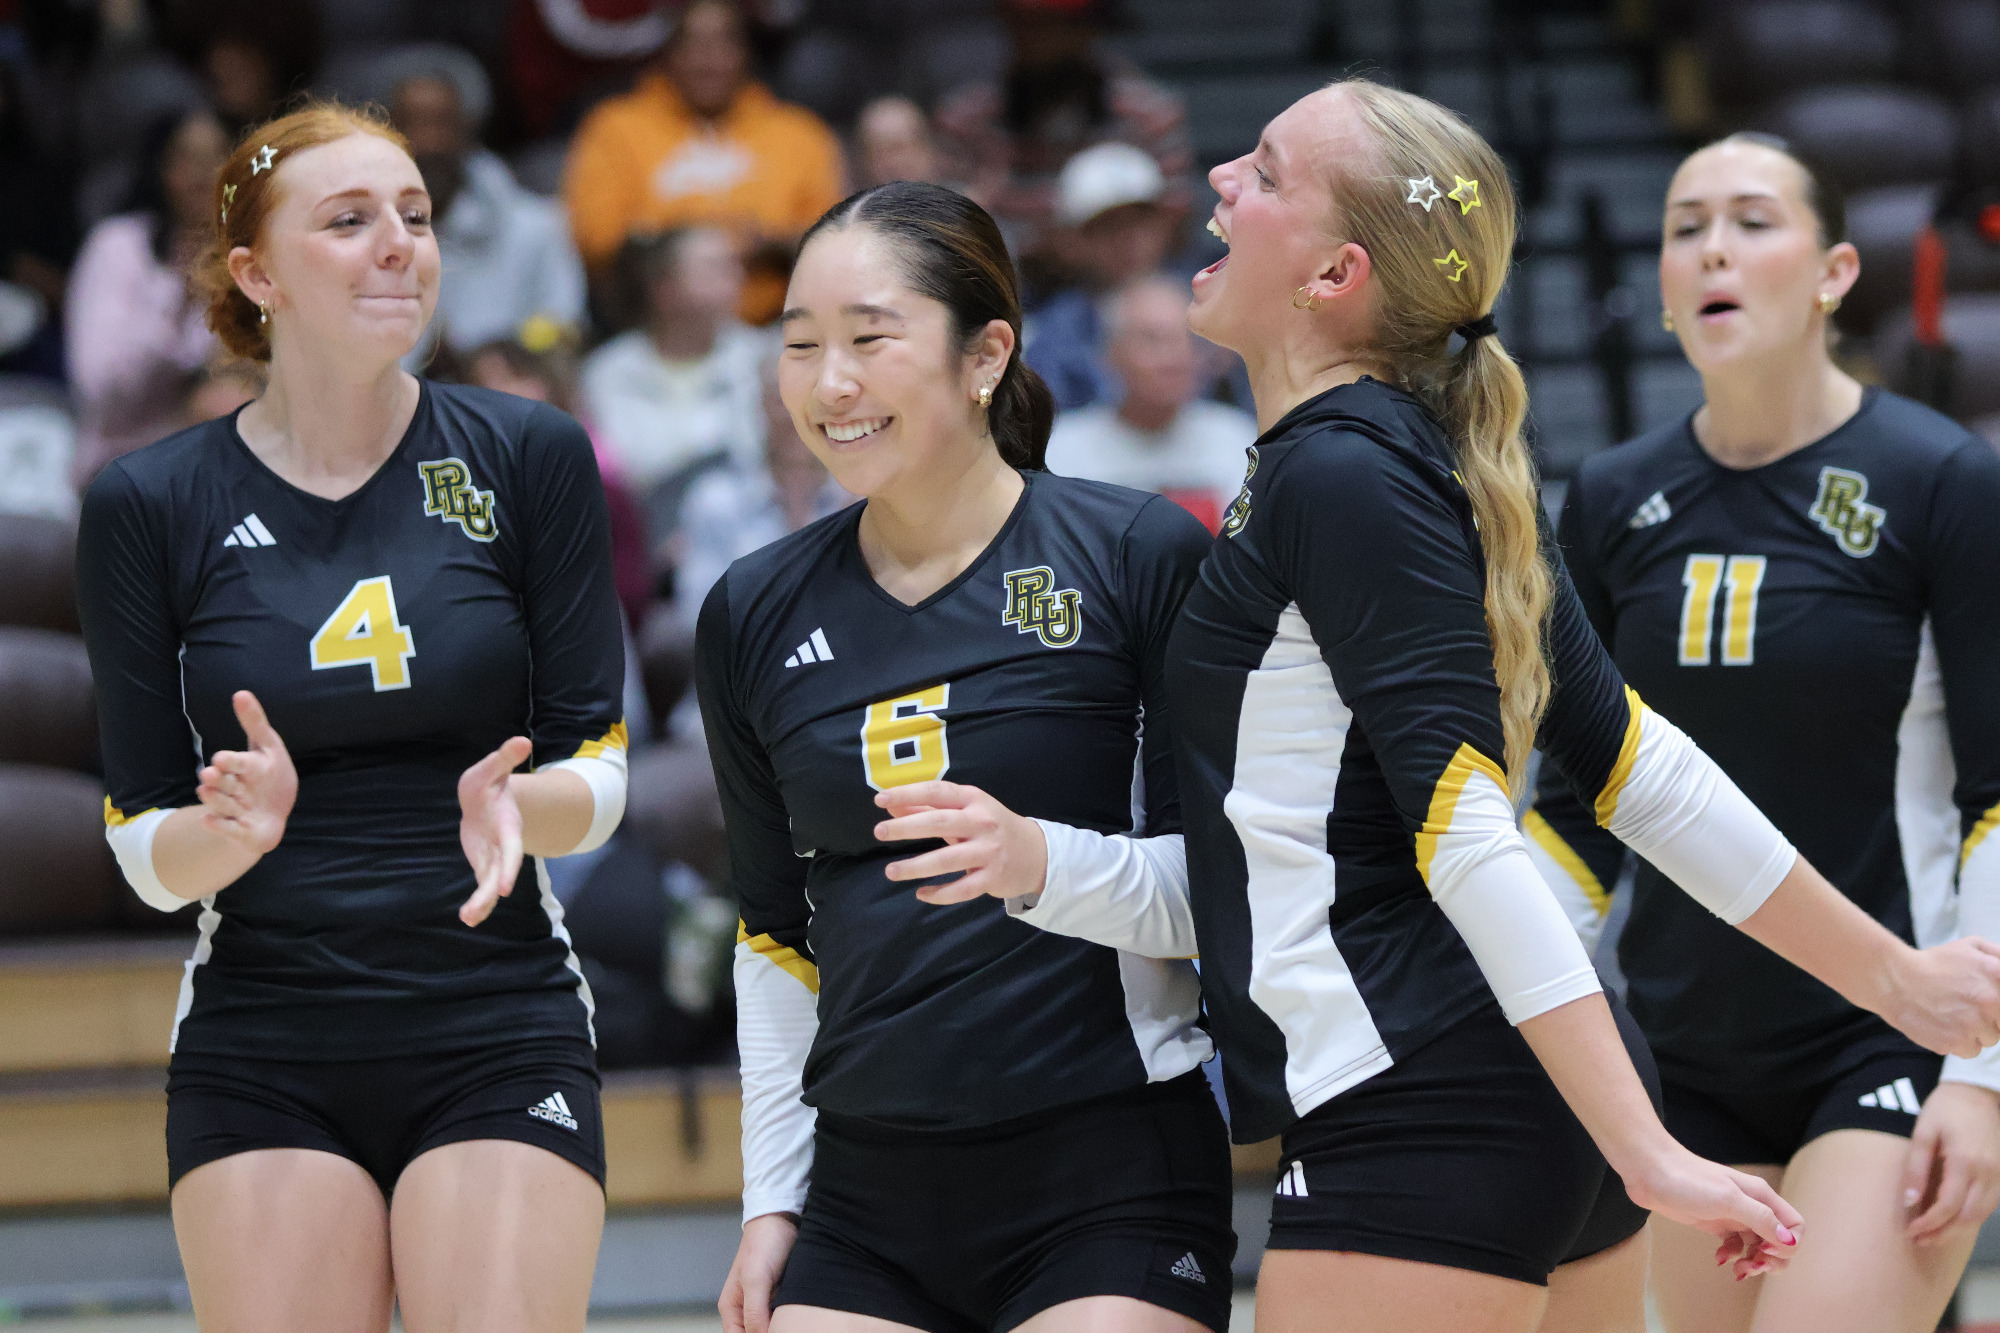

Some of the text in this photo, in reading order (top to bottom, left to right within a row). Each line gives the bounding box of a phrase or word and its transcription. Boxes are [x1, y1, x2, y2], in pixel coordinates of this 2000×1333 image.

[417, 457, 499, 543] PLU
[309, 574, 417, 693] 4
[1002, 565, 1083, 649] PLU
[1678, 553, 1767, 667] 11
[860, 682, 951, 793] 6
[527, 1106, 578, 1131] adidas
[1171, 1266, 1206, 1284] adidas
